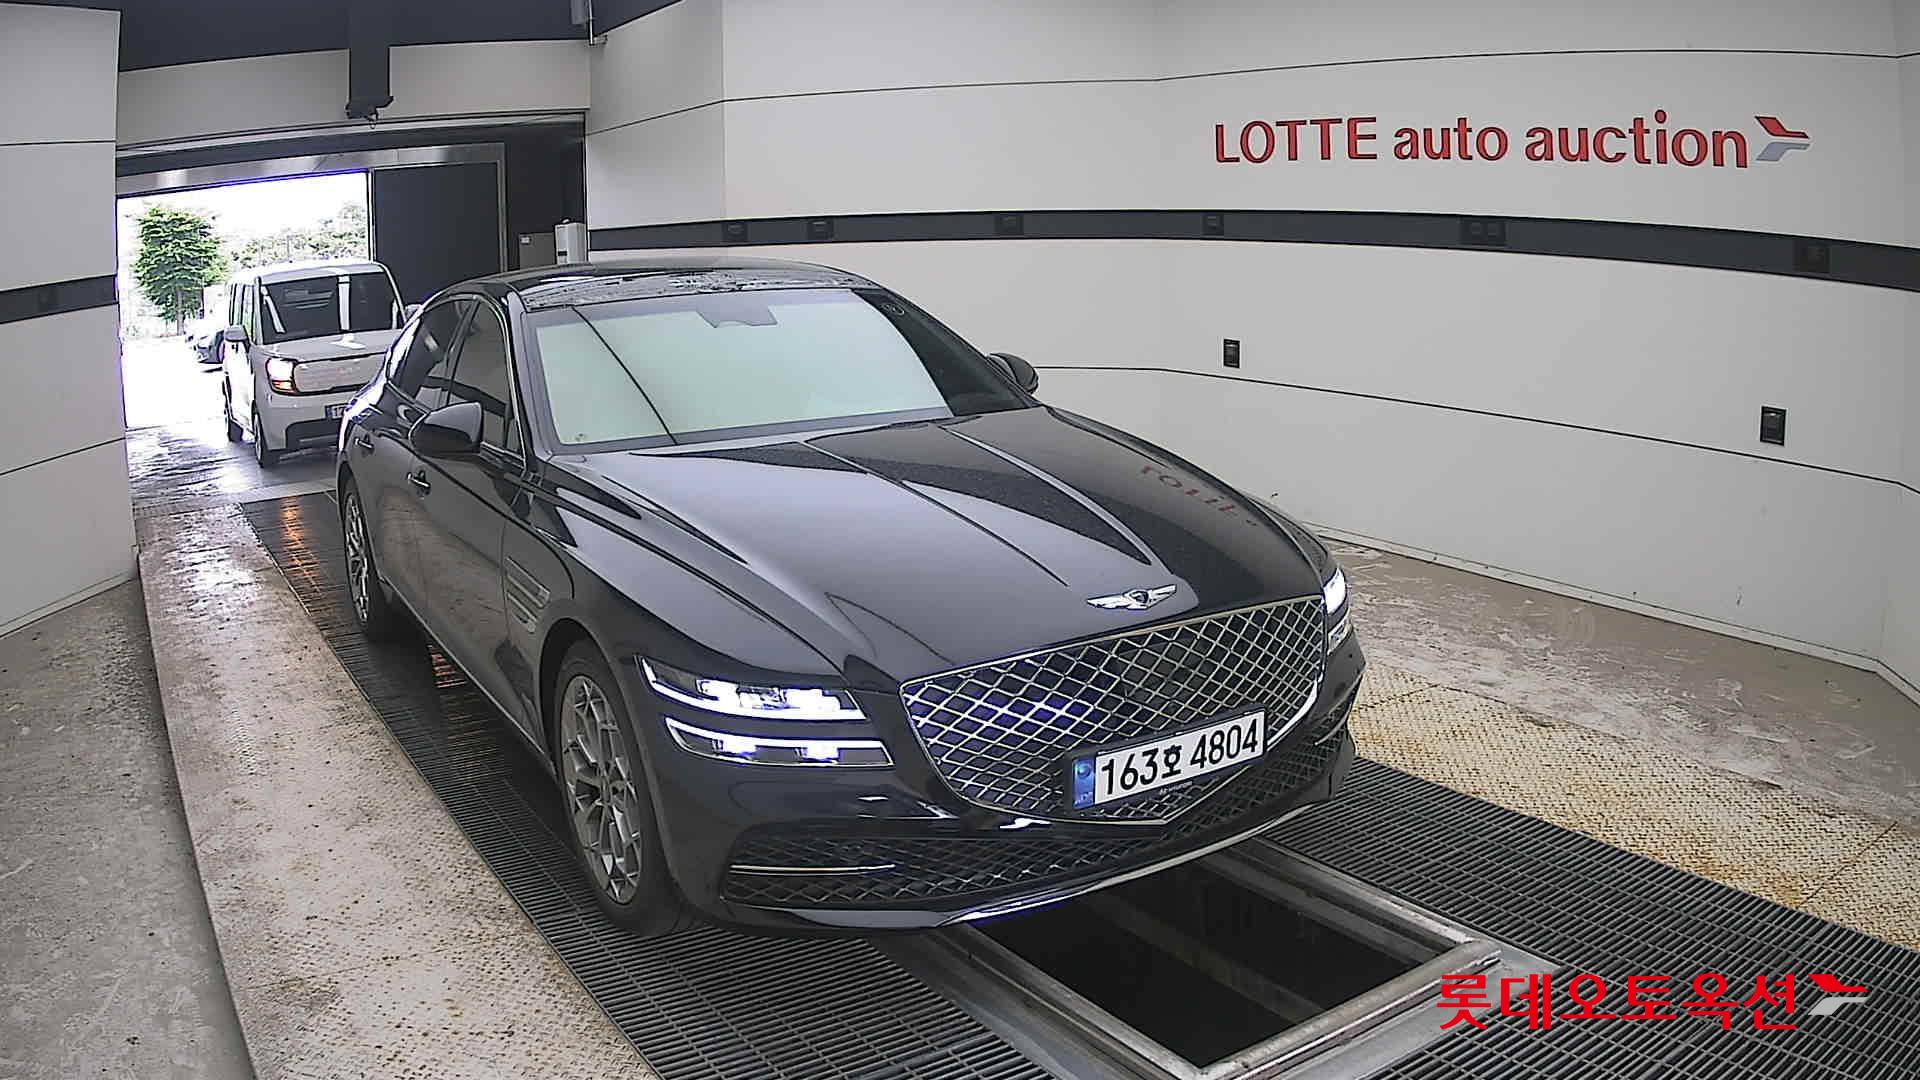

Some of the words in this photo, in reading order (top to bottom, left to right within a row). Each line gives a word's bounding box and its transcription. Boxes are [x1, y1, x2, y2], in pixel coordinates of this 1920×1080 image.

[1214, 116, 1377, 164] LOTTE
[1393, 116, 1509, 161] auto
[1525, 109, 1749, 168] auction
[1101, 743, 1183, 796] 163호
[1190, 718, 1259, 769] 4804
